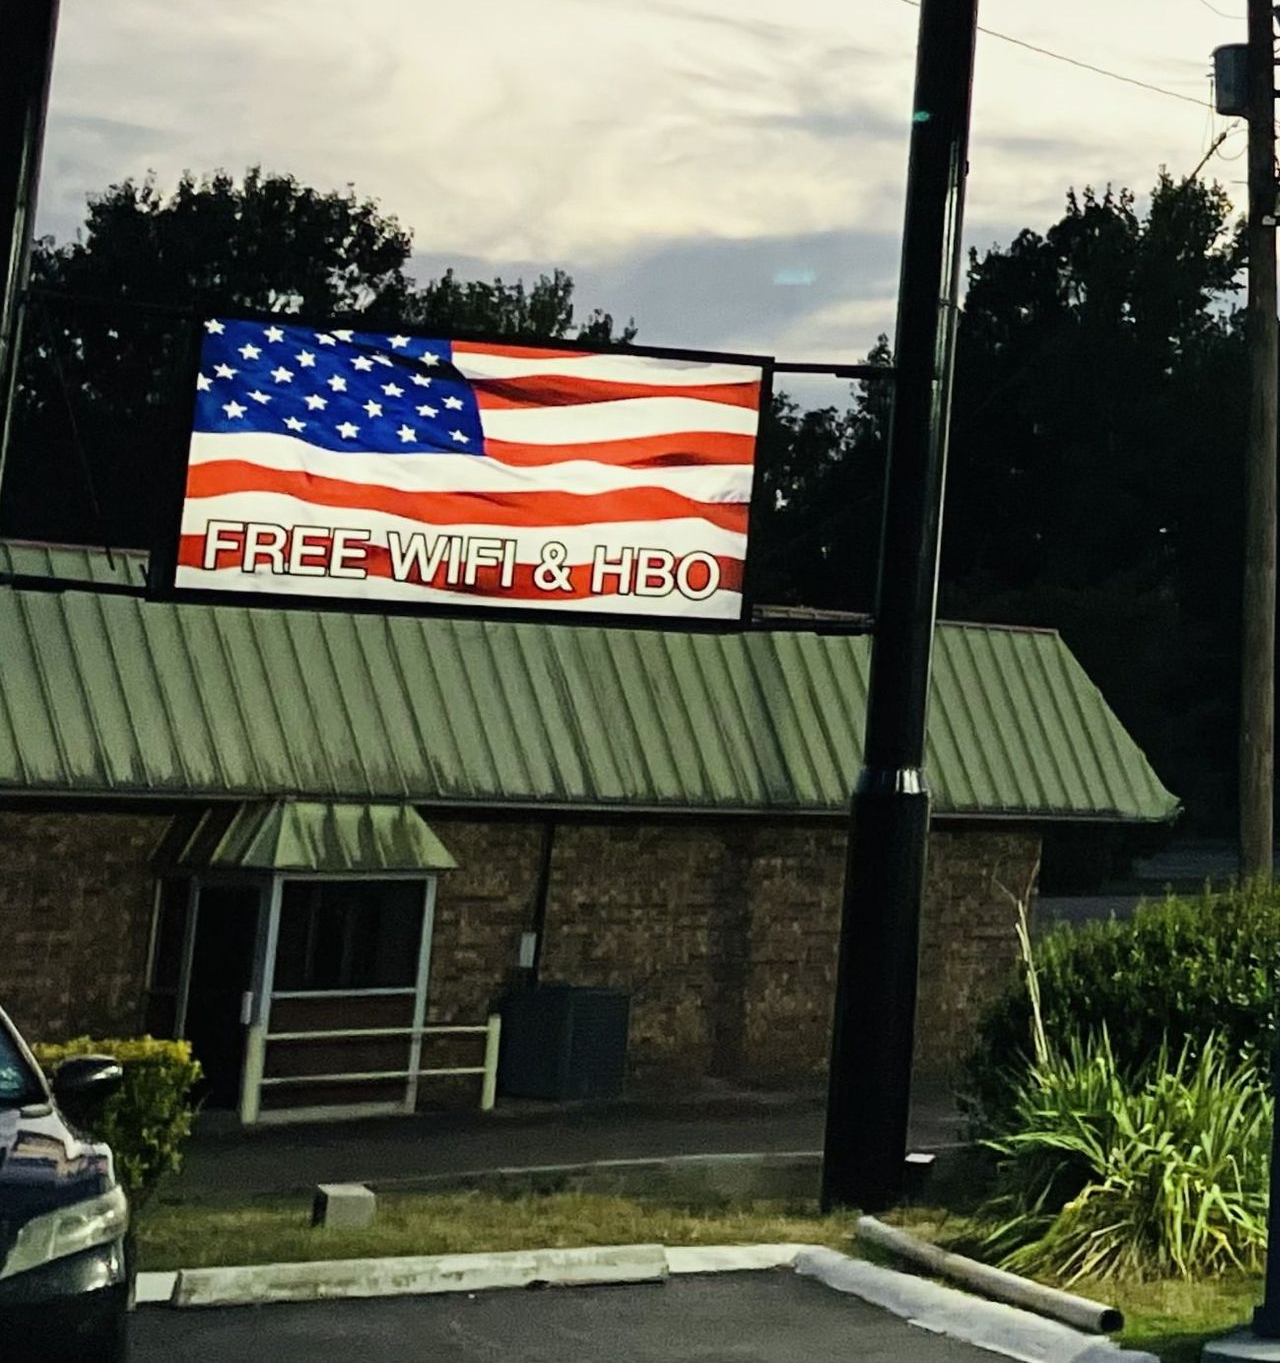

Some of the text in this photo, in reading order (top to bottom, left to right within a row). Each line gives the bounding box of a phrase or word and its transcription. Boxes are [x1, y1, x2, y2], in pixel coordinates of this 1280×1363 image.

[203, 518, 721, 602] FREE WIFI & HBO
